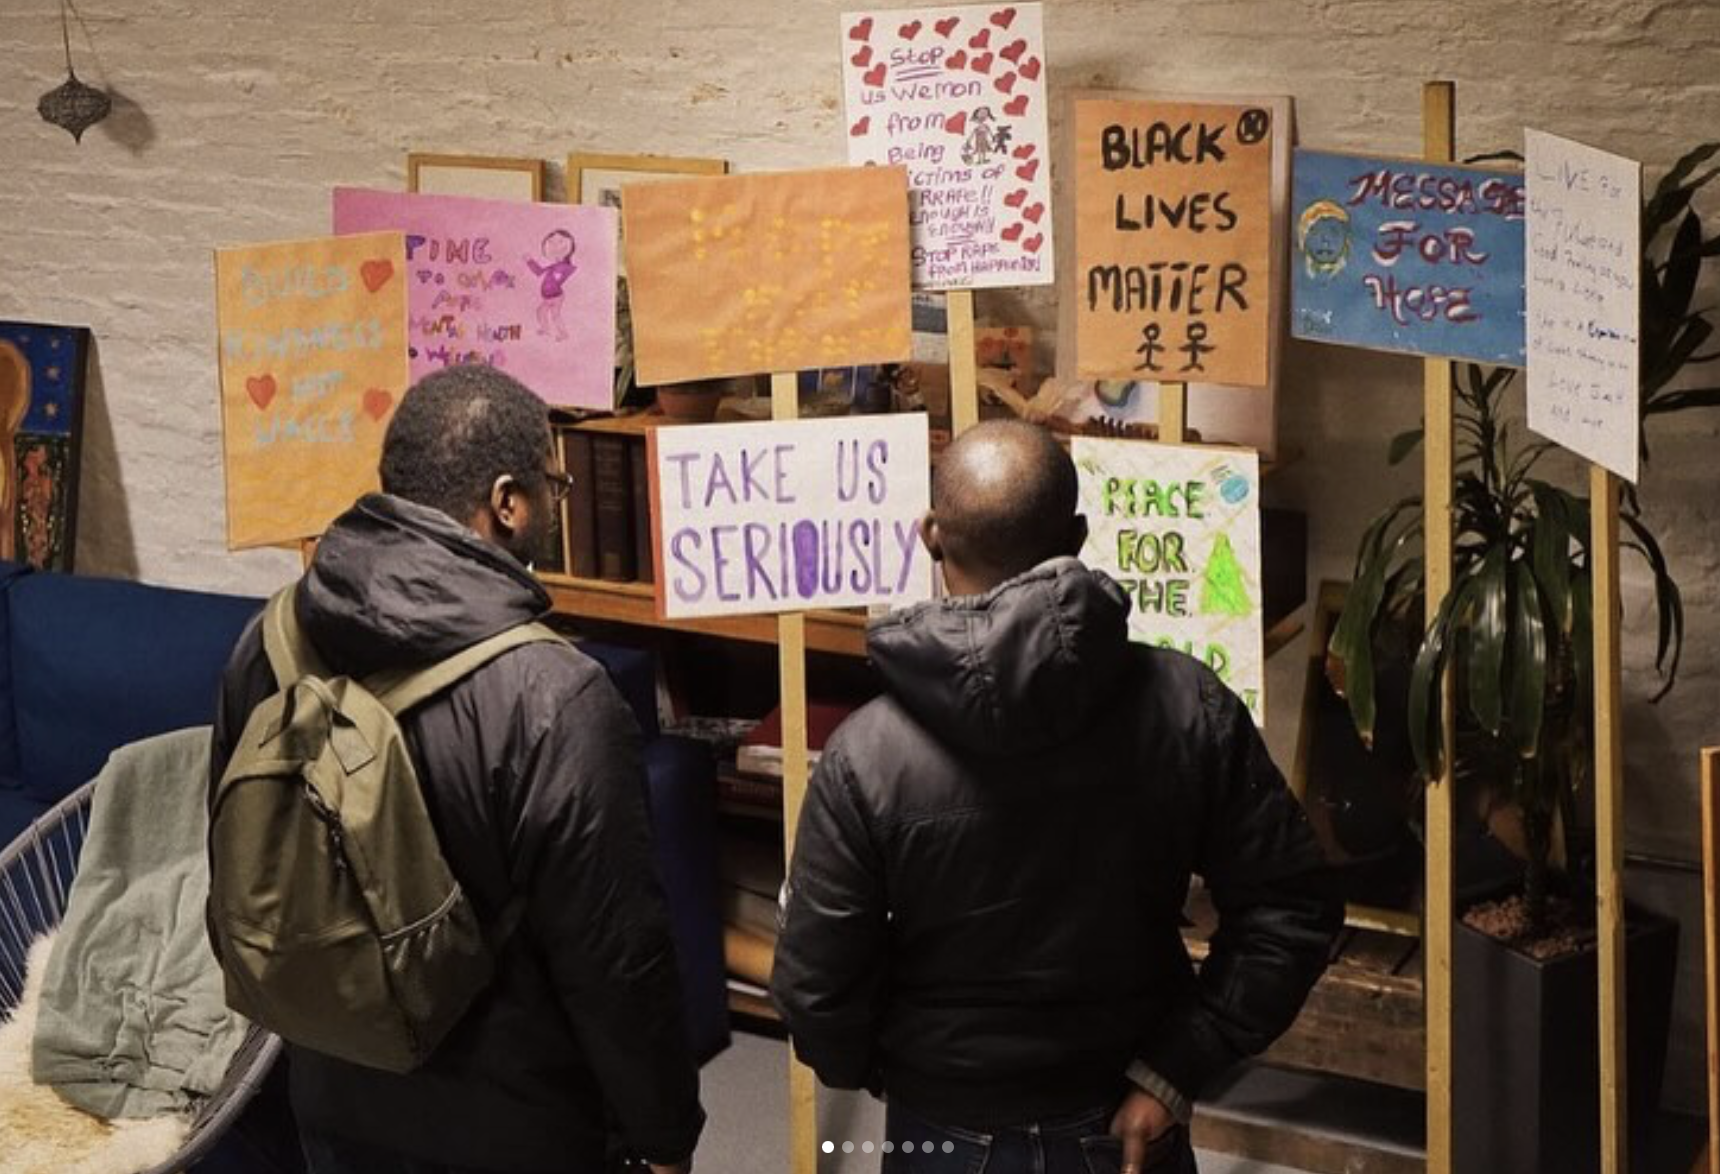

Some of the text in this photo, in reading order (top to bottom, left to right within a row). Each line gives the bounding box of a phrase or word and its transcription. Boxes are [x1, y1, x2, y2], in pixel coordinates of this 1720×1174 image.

[890, 47, 944, 69] Stop
[887, 112, 945, 137] from
[1101, 121, 1227, 171] BLACK
[888, 142, 945, 164] Being
[1115, 192, 1238, 233] LIVES
[1347, 170, 1526, 221] MESSAGE
[1372, 221, 1490, 267] FOR
[242, 264, 348, 307] BUILD
[1088, 262, 1248, 315] MATTER
[1363, 273, 1483, 326] HOPE
[225, 317, 383, 364] KINDNESS
[665, 439, 888, 509] TAKE US
[671, 519, 921, 602] SERIOUSLY
